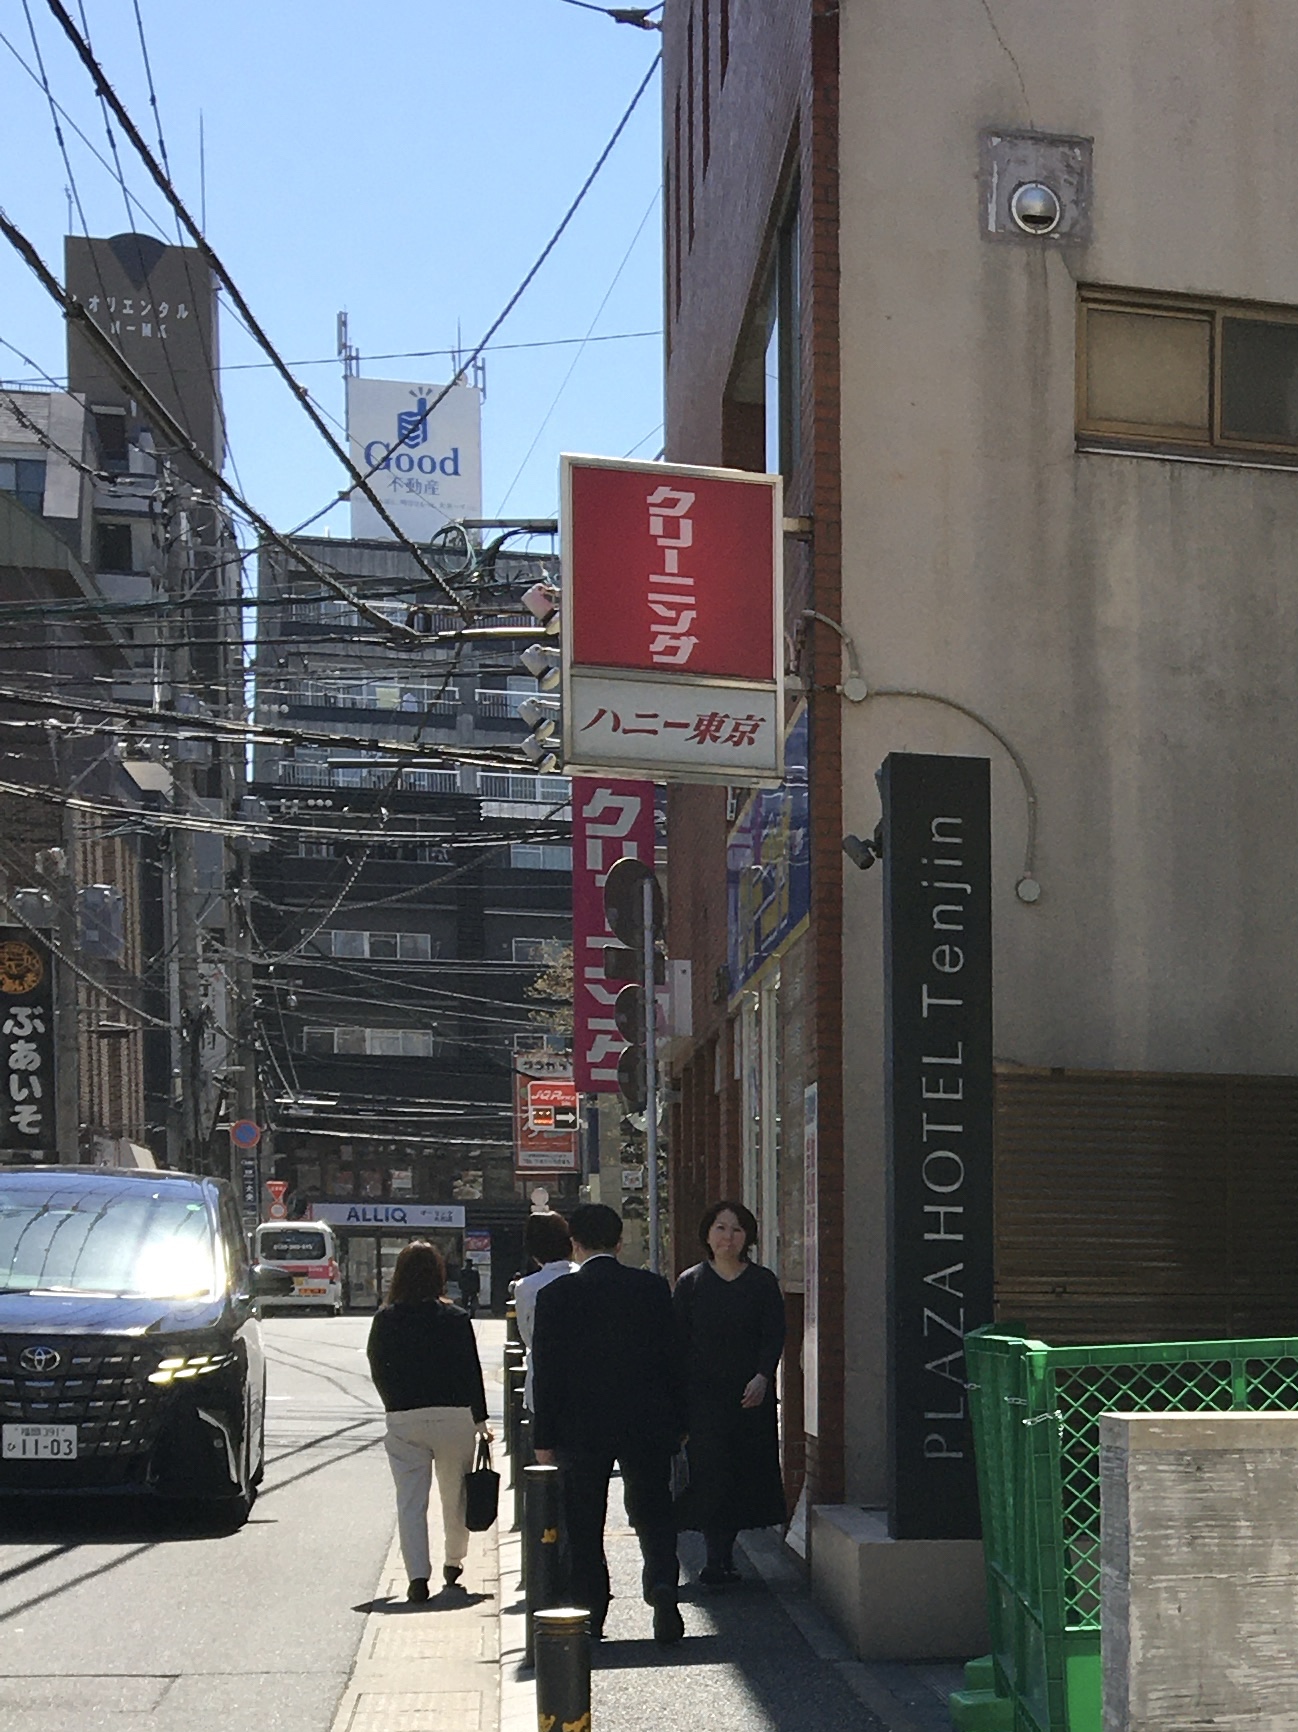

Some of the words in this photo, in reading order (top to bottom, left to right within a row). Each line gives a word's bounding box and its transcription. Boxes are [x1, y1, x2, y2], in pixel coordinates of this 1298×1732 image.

[364, 441, 461, 476] Good
[387, 476, 440, 496] 不動産
[647, 486, 699, 664] クリーニング
[580, 708, 766, 747] ハニー東京
[921, 817, 971, 1018] Tenjin
[3, 1006, 45, 1134] ぶあいそ
[922, 1042, 964, 1240] HOTEL
[347, 1206, 407, 1224] ALLIQ
[923, 1263, 964, 1458] PLAZA
[22, 1439, 73, 1456] 11-03
